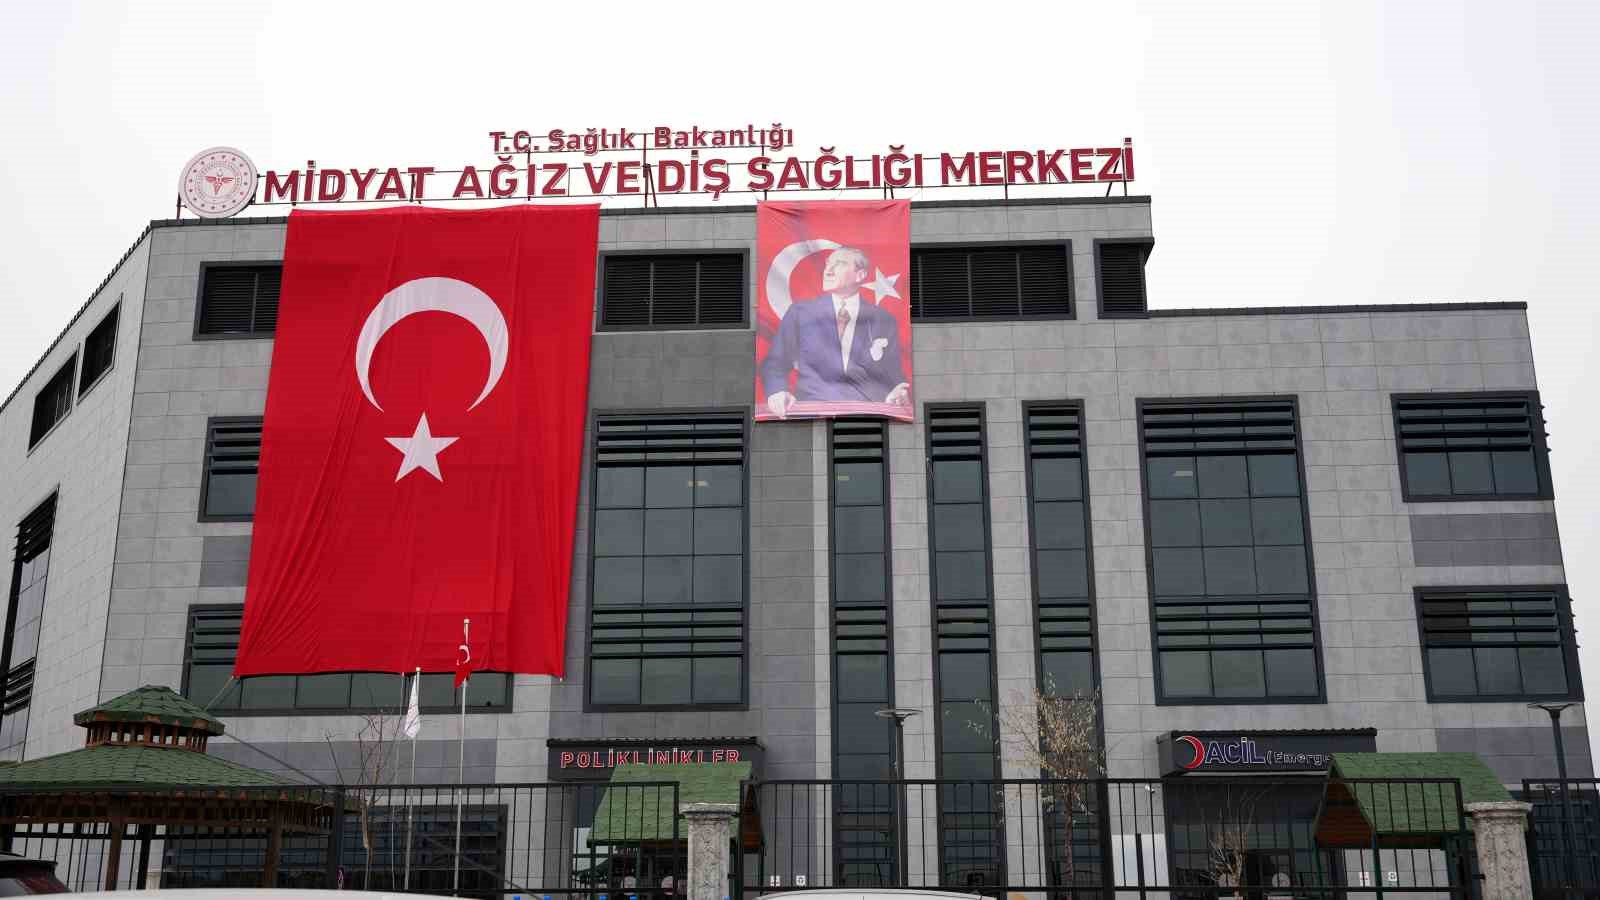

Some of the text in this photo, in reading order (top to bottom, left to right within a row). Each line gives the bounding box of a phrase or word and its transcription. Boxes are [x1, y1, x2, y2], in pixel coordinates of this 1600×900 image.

[489, 123, 794, 155] T.C. Sağlık Bakanlığı
[263, 160, 434, 202] MİDYAT
[452, 155, 569, 199] AĞIZ
[584, 160, 642, 195] VE
[657, 150, 731, 200] DİŞ
[747, 145, 924, 191] SAĞLIĞI
[941, 137, 1136, 186] MERKEZİ
[1204, 736, 1266, 764] ACİL
